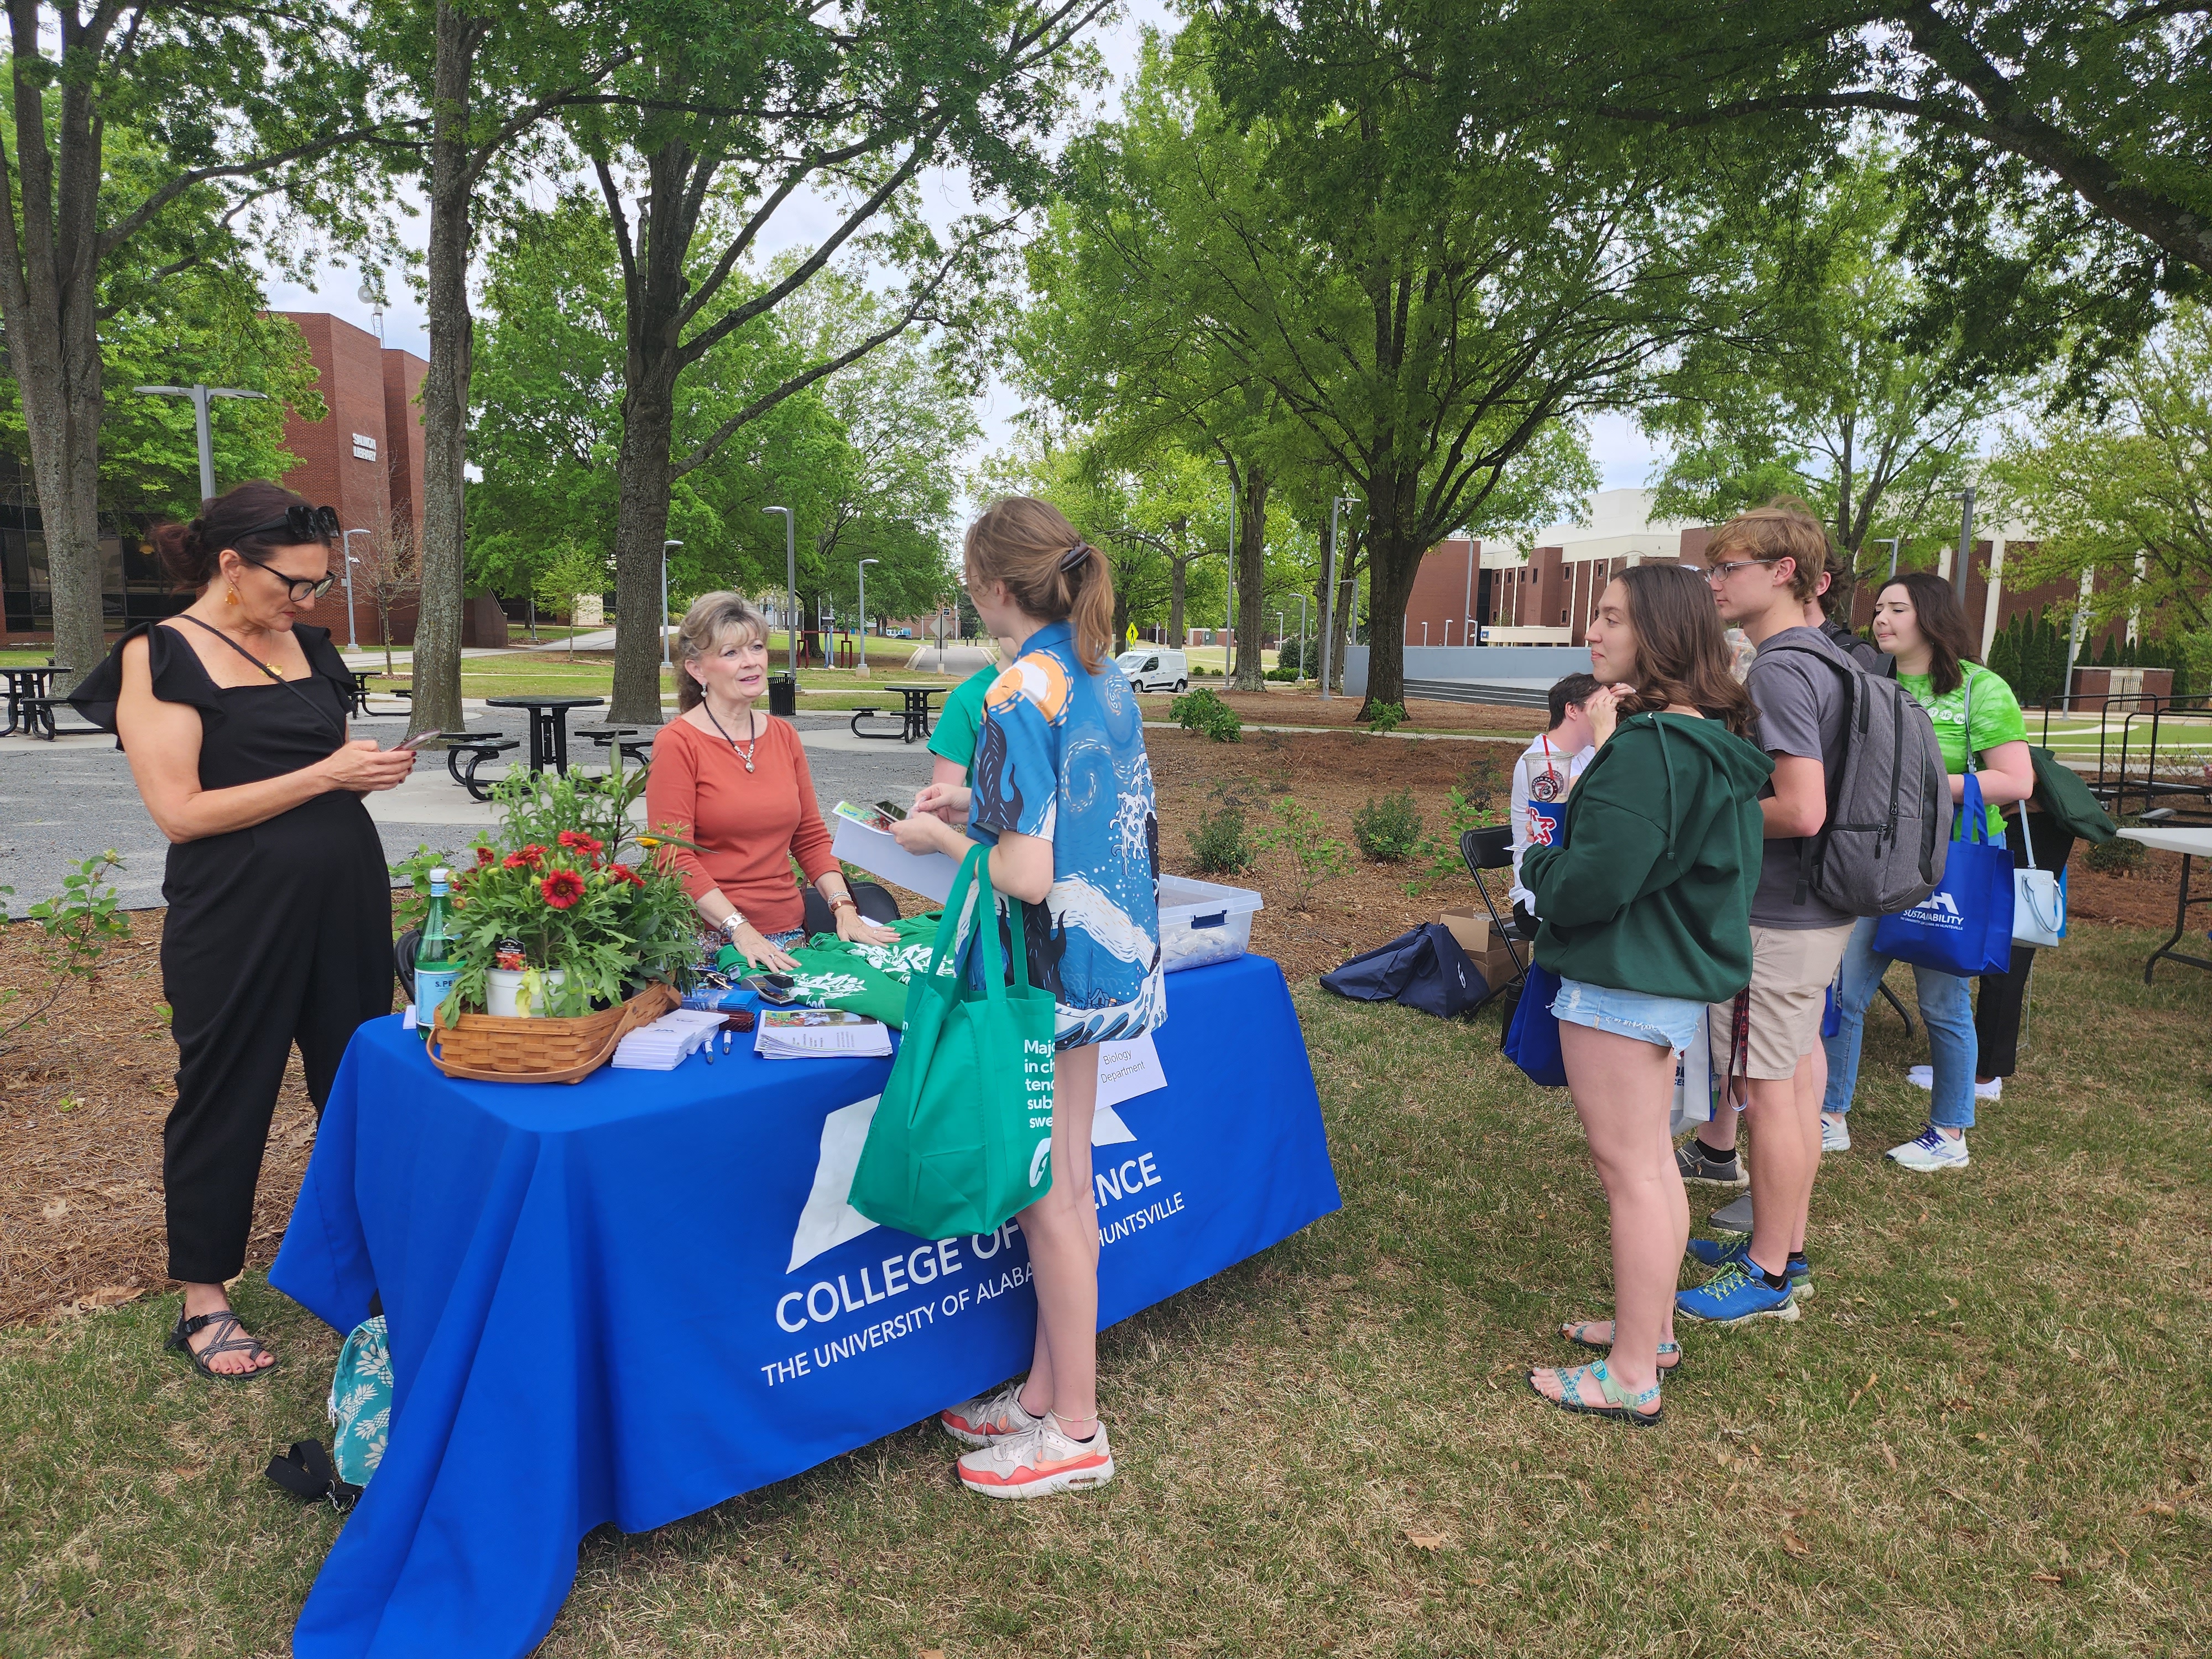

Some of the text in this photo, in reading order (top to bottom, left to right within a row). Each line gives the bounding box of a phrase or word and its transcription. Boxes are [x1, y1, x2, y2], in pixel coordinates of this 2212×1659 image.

[353, 446, 376, 462] LIBRARY
[1024, 1058, 1038, 1073] in
[1103, 1050, 1131, 1065] Biology
[1100, 1060, 1145, 1083] Department
[776, 1238, 963, 1333] COLLEGE
[761, 1352, 811, 1386] THE
[813, 1302, 935, 1368] UNIVERSITY
[942, 1288, 970, 1316] OF
